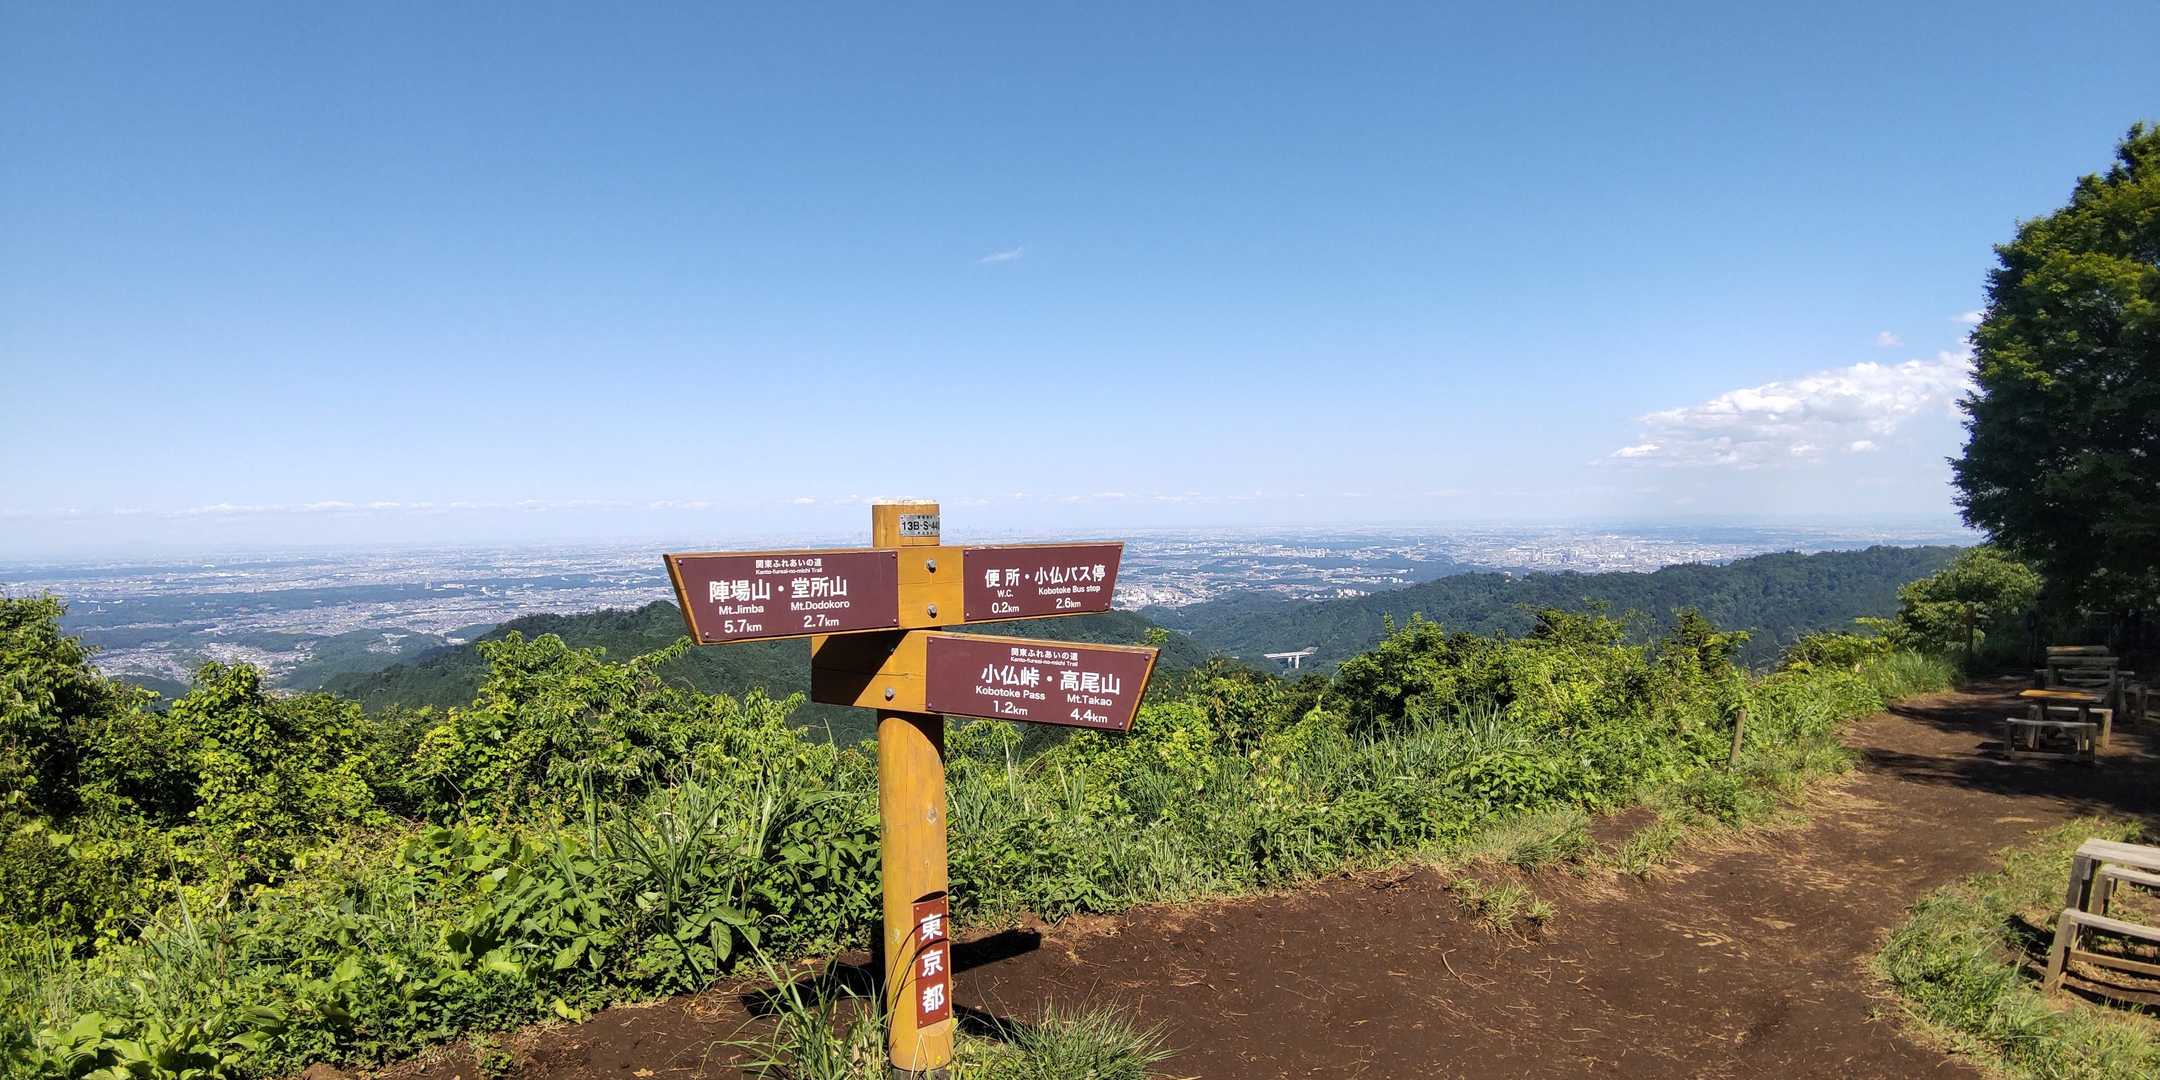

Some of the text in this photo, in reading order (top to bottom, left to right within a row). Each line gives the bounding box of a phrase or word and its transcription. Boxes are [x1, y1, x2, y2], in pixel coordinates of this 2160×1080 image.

[709, 576, 847, 603] 陣場山・堂所山
[997, 585, 1100, 598] W.C. Kobotoke Bus stop
[718, 600, 850, 615] Mt.Jimba Mt.Dodokoro
[991, 598, 1081, 614] 0.2km 2.6km
[724, 614, 839, 634] 5.7km 2.7km
[981, 664, 1120, 695] 小仏峠・高尾山
[975, 685, 1113, 707] Kobotoke Pass Mt.Takao
[993, 700, 1108, 724] 1.2km 4.4km
[920, 913, 944, 1013] 東京都
